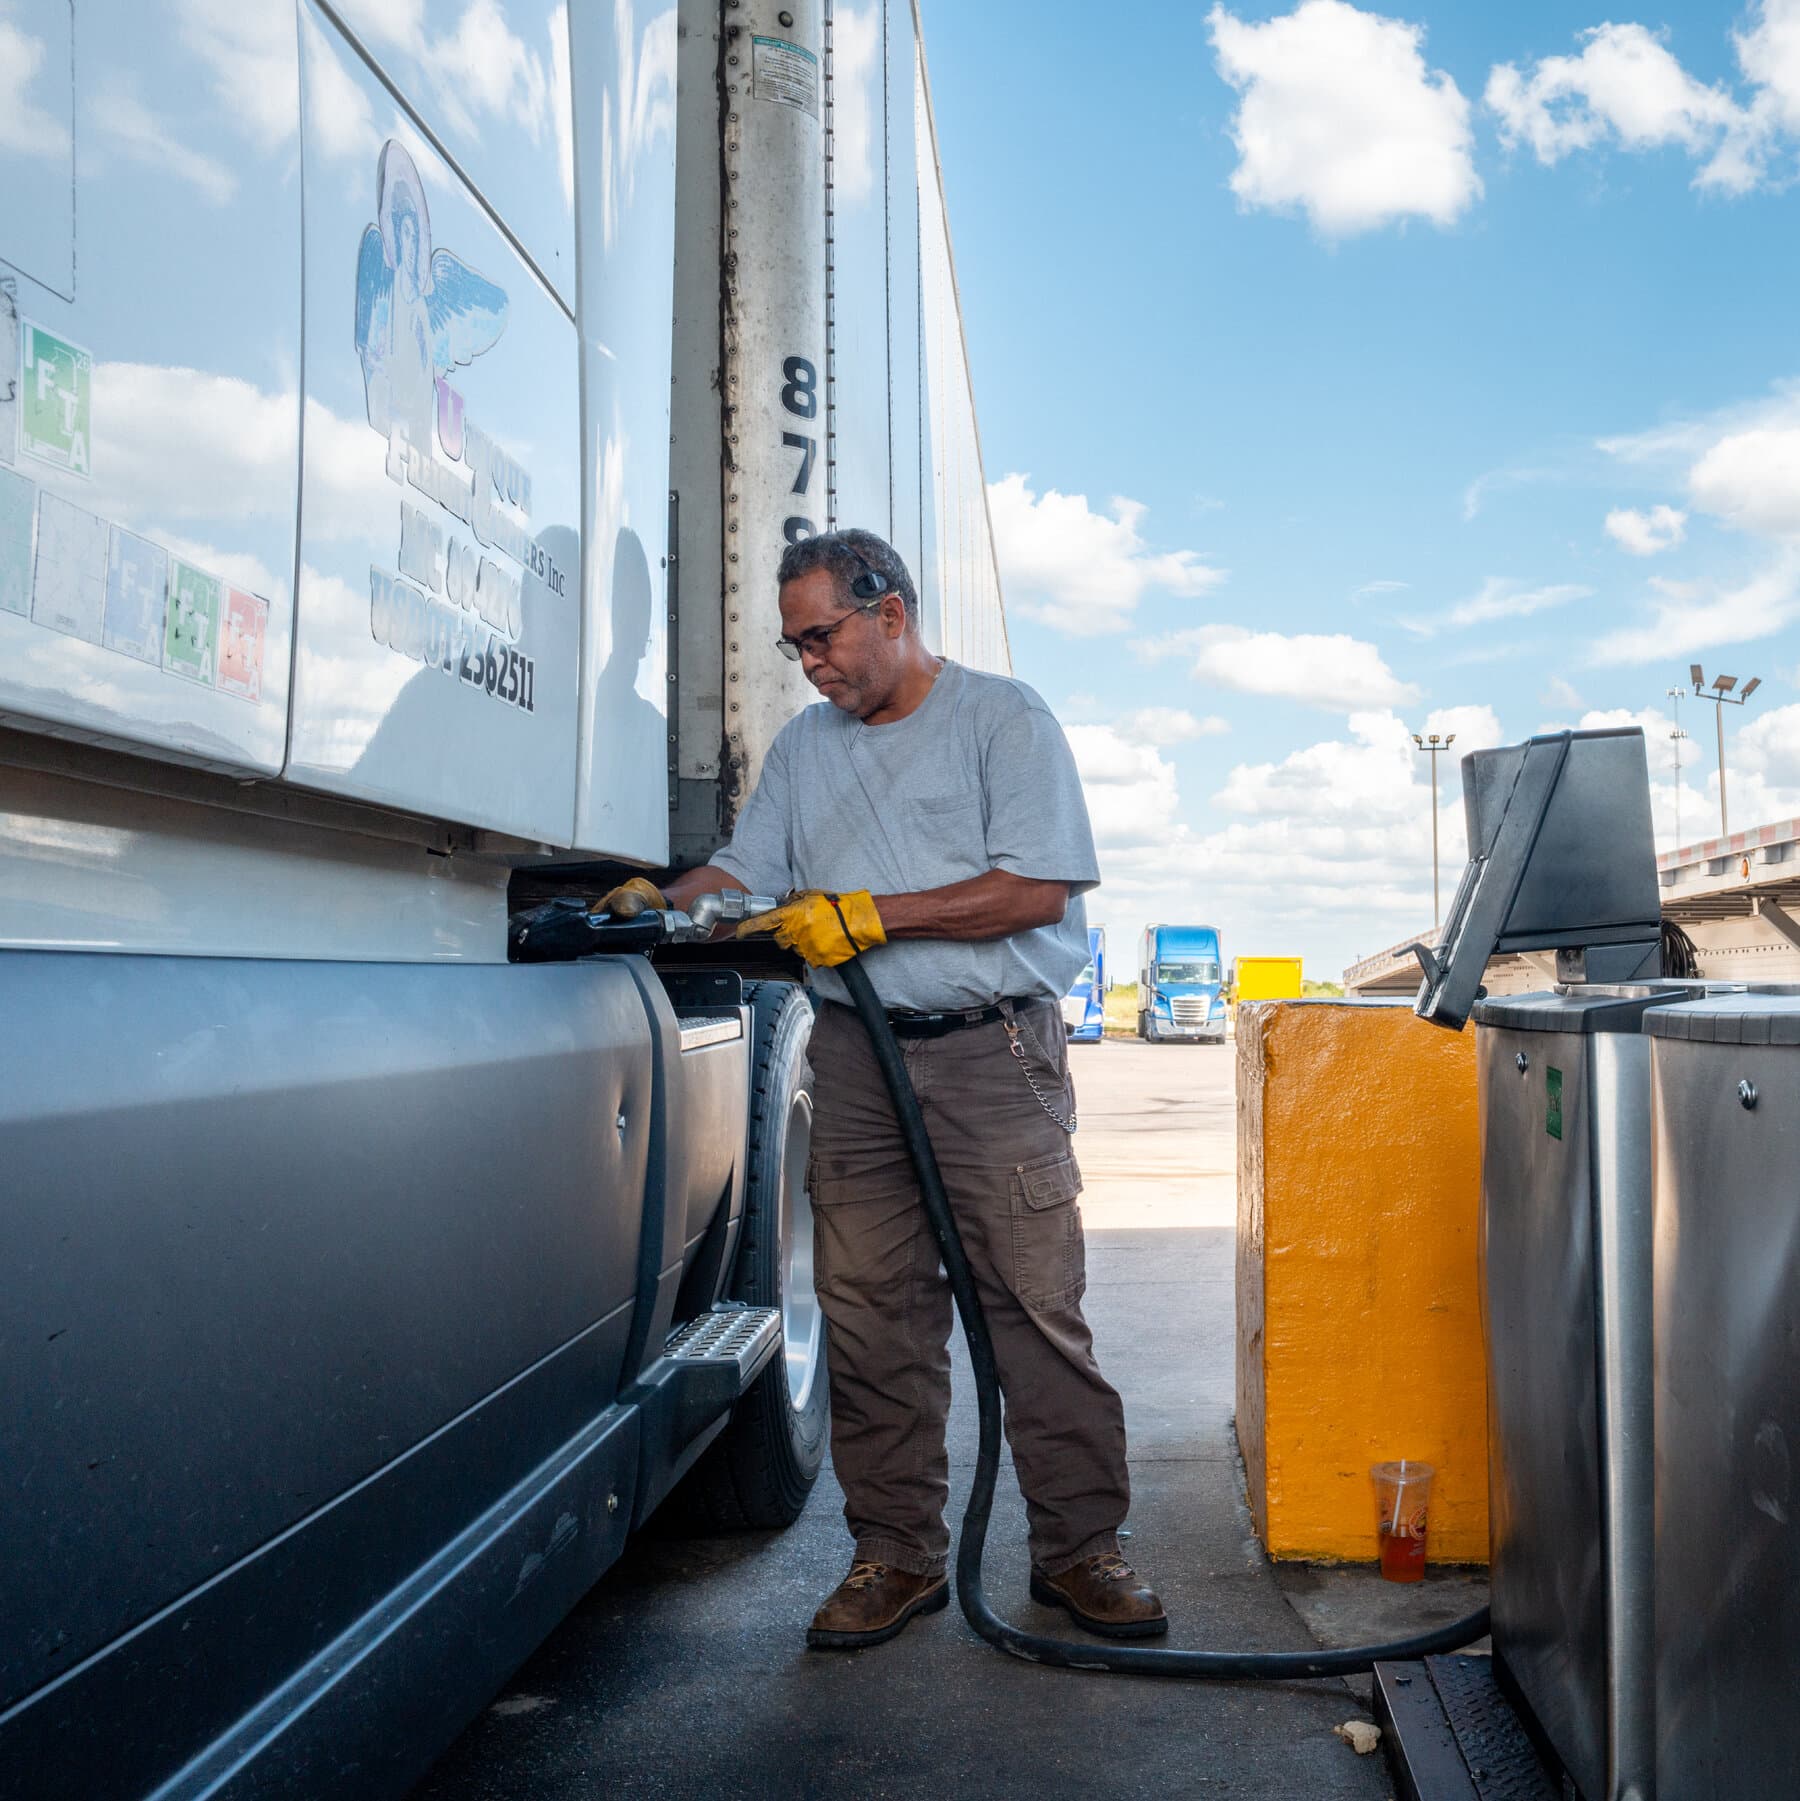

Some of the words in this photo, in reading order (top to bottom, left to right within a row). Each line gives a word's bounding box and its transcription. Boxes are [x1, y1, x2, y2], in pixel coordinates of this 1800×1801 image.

[436, 375, 531, 515] UQUE
[547, 556, 565, 598] Inc
[460, 618, 534, 712] 2562511
